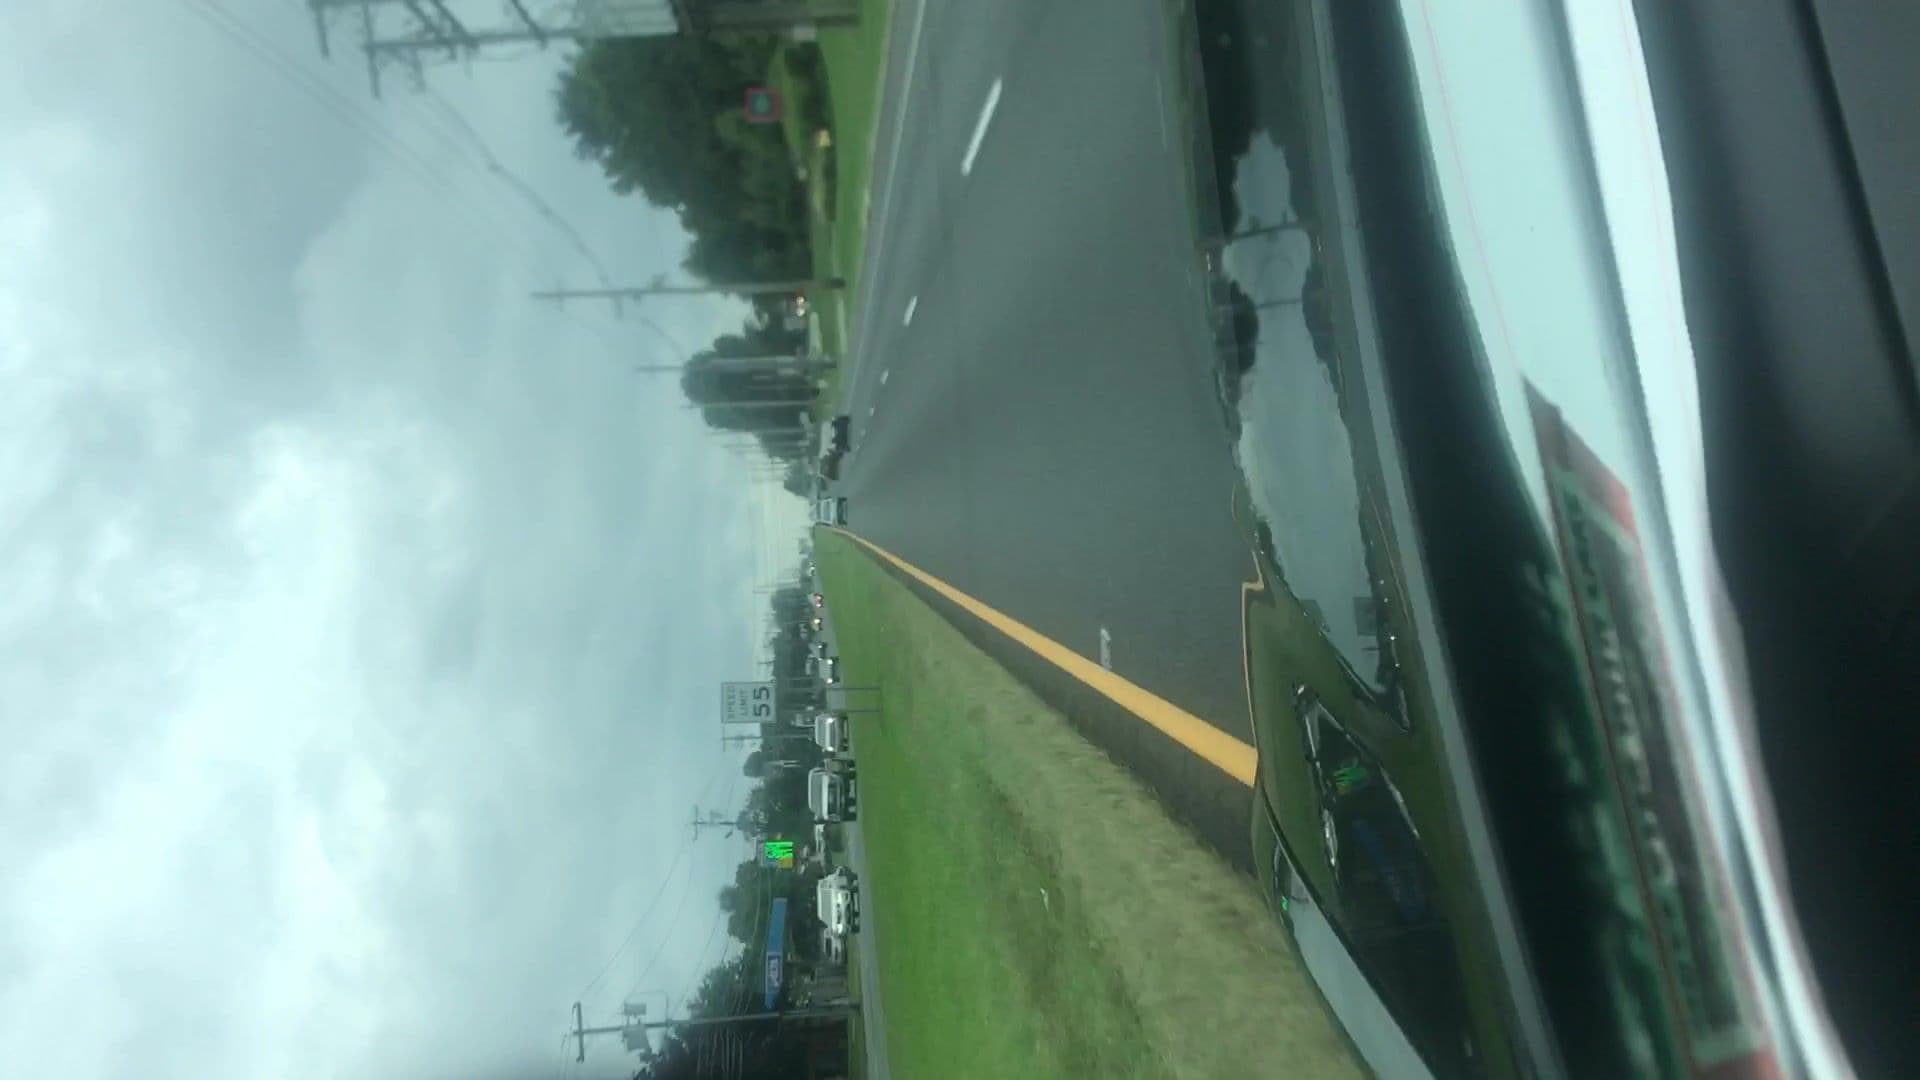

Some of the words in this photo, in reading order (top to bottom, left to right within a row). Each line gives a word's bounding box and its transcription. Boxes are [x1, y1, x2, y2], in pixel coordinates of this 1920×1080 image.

[727, 685, 737, 719] SPEED
[738, 688, 748, 717] LIMIT
[753, 686, 770, 716] 55
